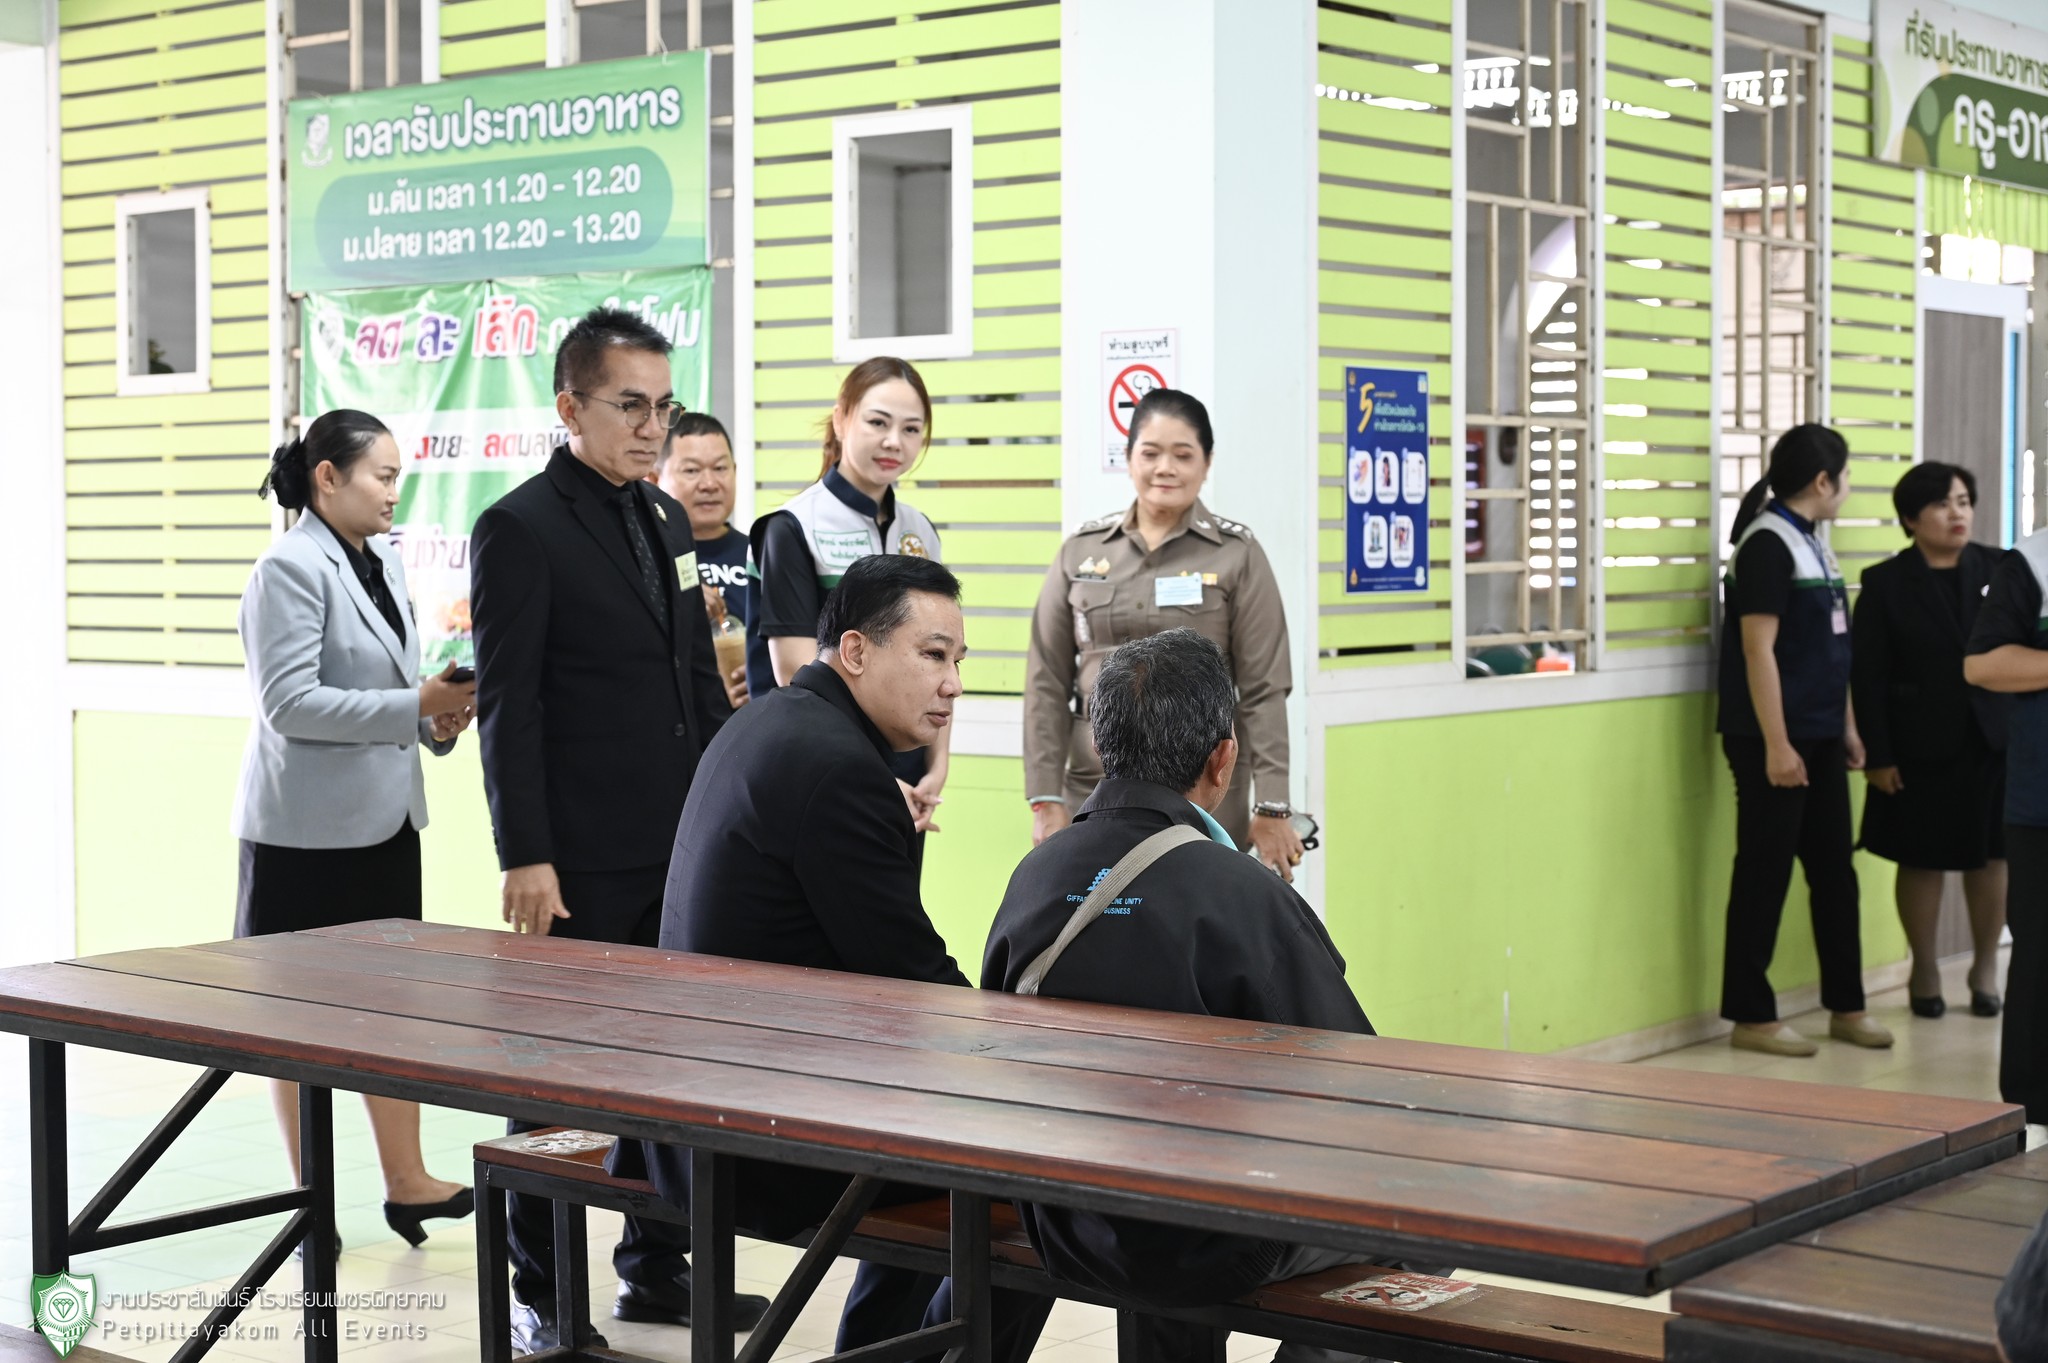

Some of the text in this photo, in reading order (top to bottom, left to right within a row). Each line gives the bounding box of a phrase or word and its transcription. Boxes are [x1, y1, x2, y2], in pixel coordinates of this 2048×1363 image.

[344, 86, 681, 161] เวลารับประทานอาหาร
[368, 178, 421, 216] ม.ต้น
[427, 181, 475, 211] เวลา
[482, 171, 547, 205] 11.20
[572, 163, 641, 196] 12.20
[343, 227, 421, 262] ม.ปลาย
[427, 230, 475, 254] เวลา
[482, 218, 547, 251] 12.20
[572, 210, 641, 244] 13.20
[354, 319, 403, 362] ลด
[417, 314, 459, 359] ละ
[473, 297, 537, 357] เลิก
